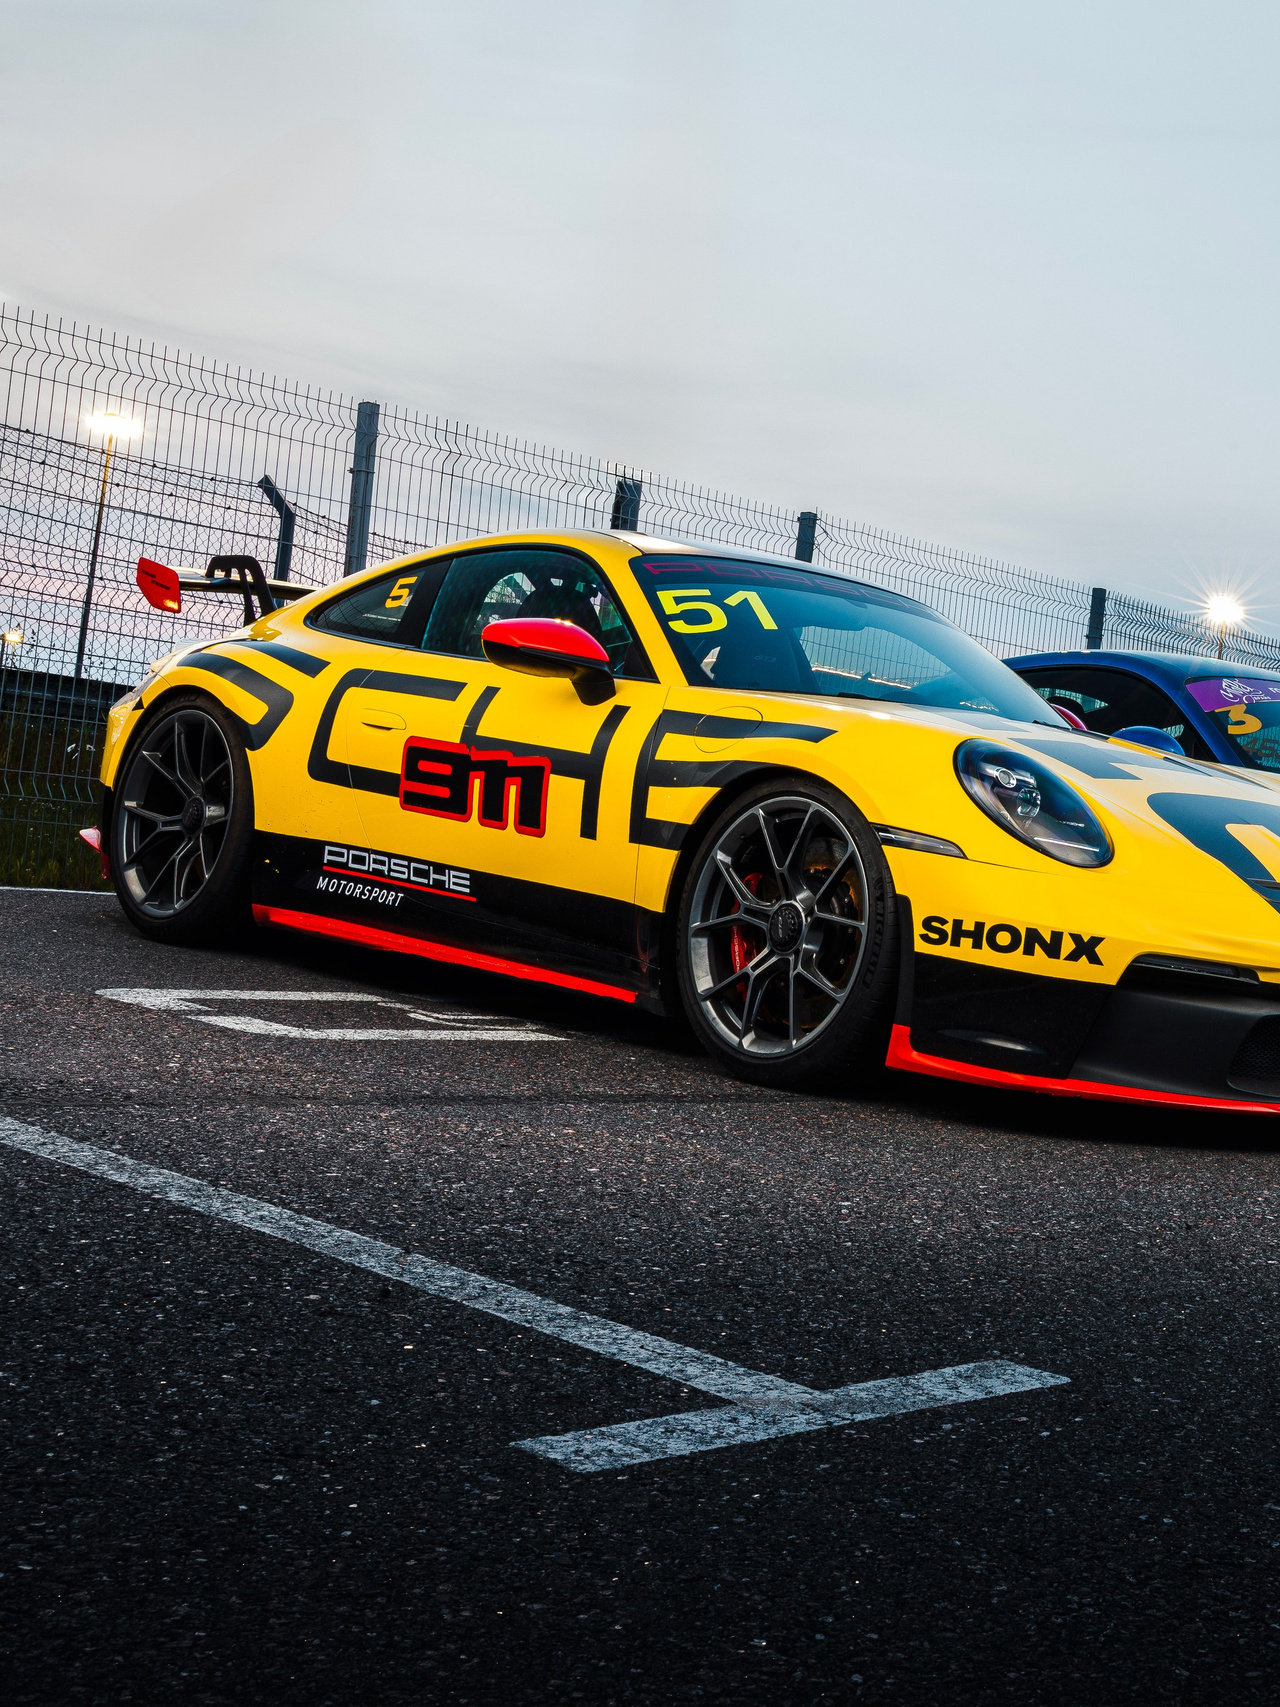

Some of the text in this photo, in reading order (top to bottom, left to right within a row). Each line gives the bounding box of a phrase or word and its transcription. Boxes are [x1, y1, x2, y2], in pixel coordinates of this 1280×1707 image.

[384, 576, 418, 609] 5
[656, 588, 779, 635] 51
[1214, 703, 1262, 735] 3
[323, 845, 471, 894] PORSCHE
[316, 876, 404, 907] MOTORSPORT
[918, 915, 1105, 966] SHONX
